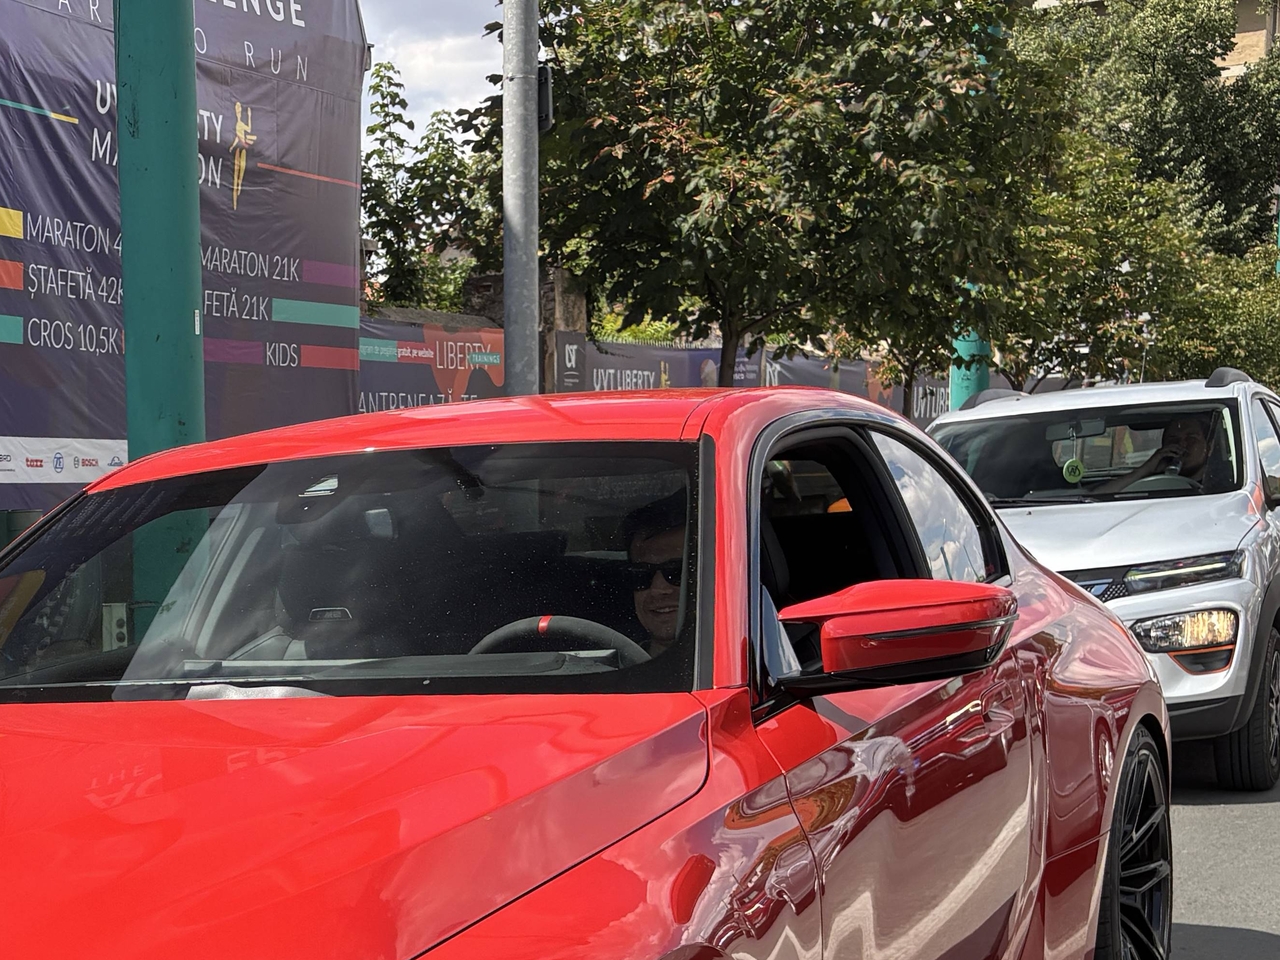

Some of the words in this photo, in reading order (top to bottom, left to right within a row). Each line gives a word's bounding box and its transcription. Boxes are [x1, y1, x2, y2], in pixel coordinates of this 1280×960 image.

[244, 41, 308, 81] RUN
[27, 212, 110, 255] MARATON
[28, 264, 96, 301] ȘTAFETĂ
[272, 255, 300, 282] 21K
[242, 295, 269, 321] 21K
[27, 318, 74, 349] CROS
[78, 323, 119, 356] 10,5K
[266, 342, 299, 367] KIDS
